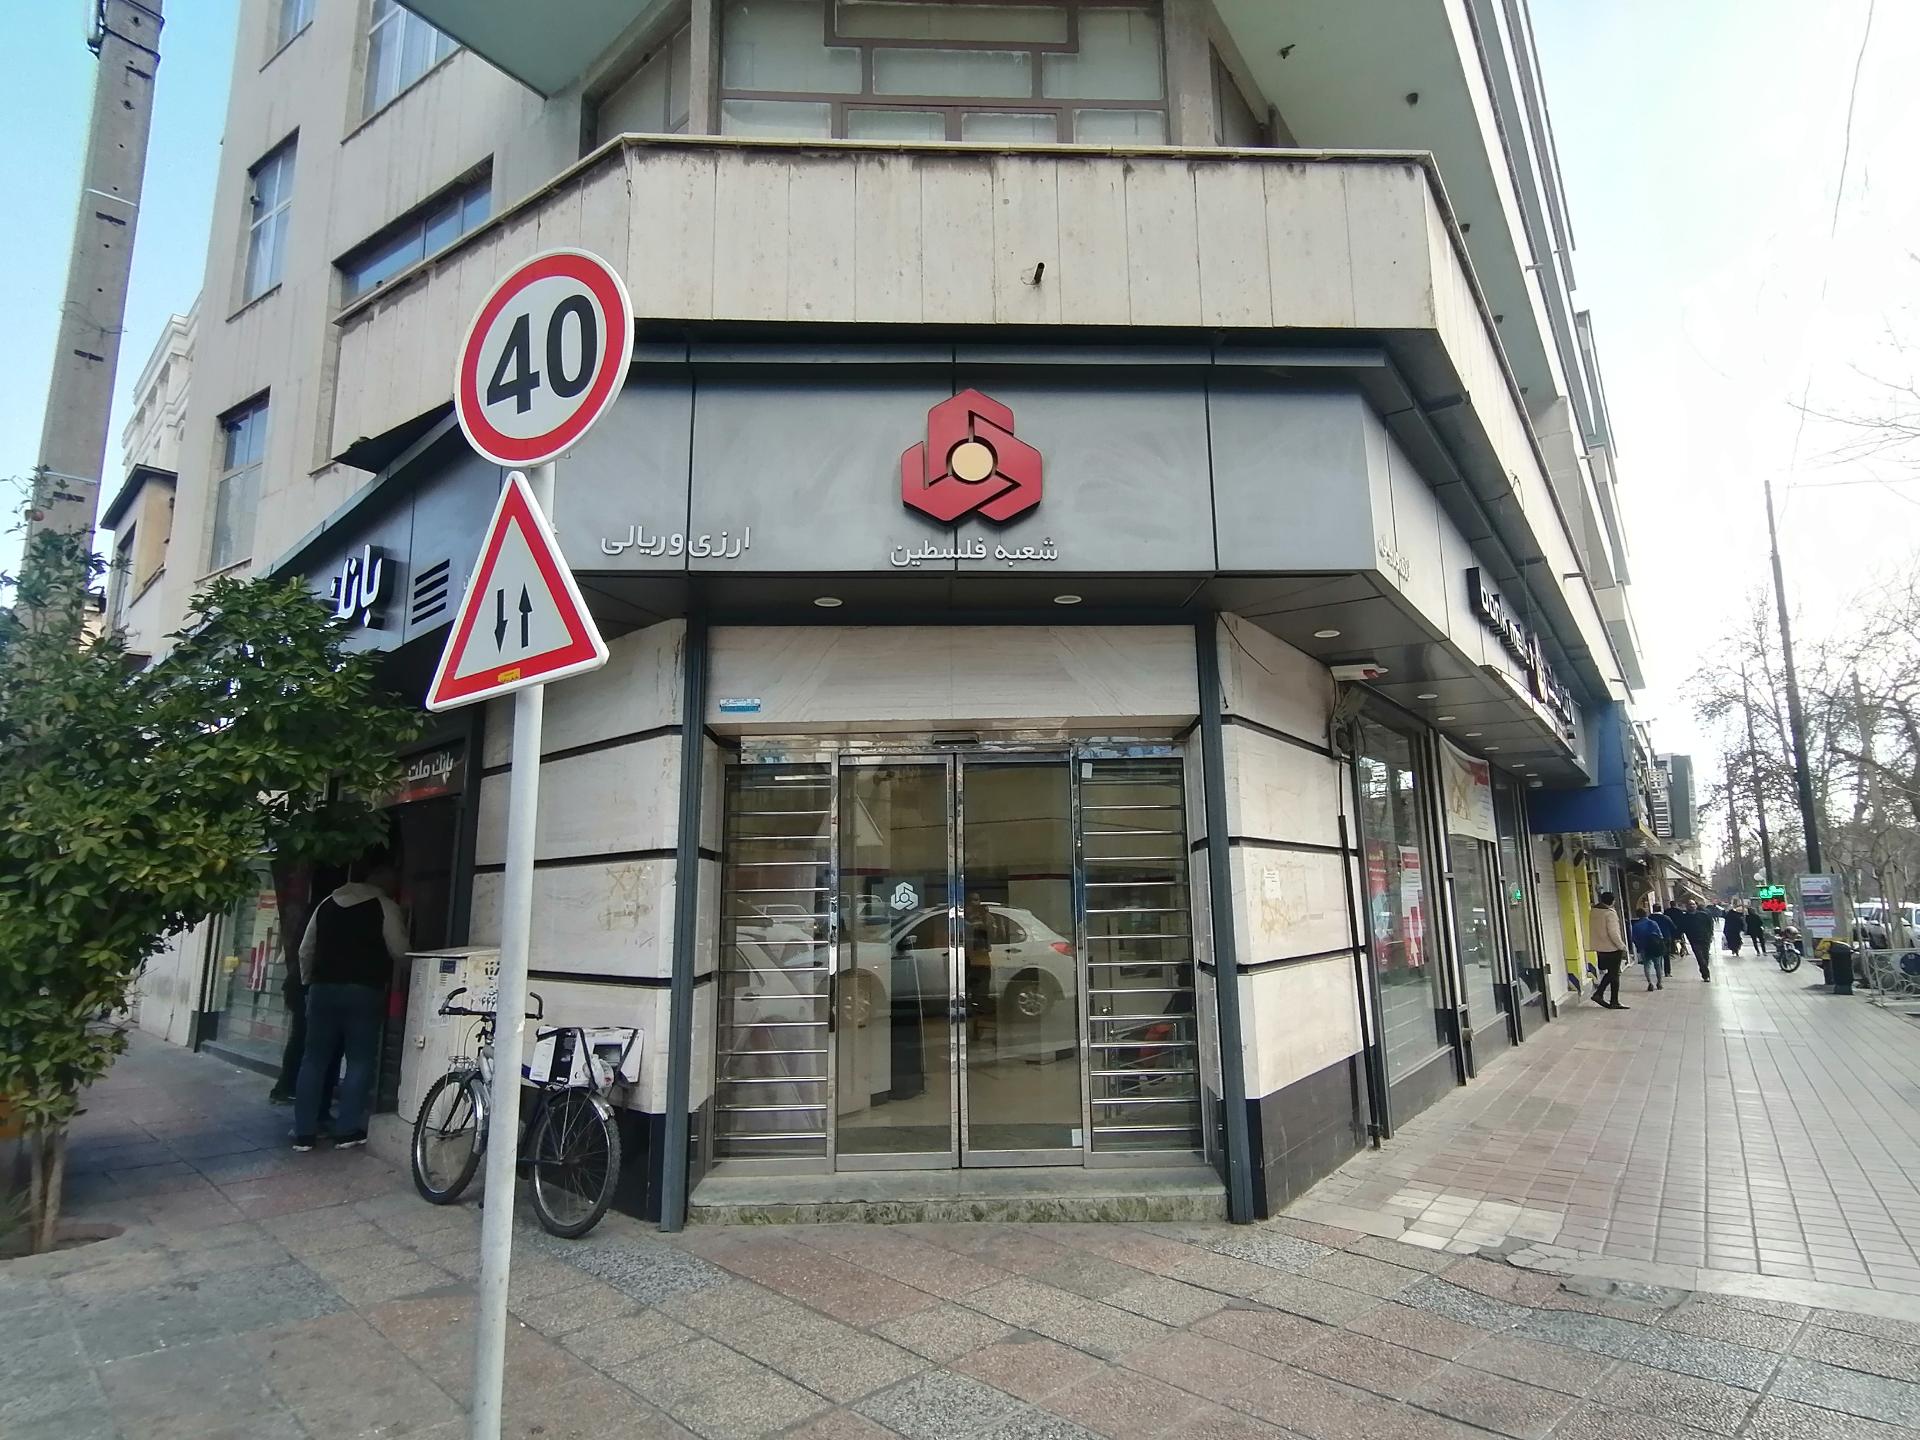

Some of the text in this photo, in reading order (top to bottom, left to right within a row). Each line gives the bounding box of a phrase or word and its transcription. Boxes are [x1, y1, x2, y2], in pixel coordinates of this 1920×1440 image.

[487, 295, 597, 414] 40
[890, 537, 1058, 566] شعبه فلسطین
[407, 760, 431, 782] ملت
